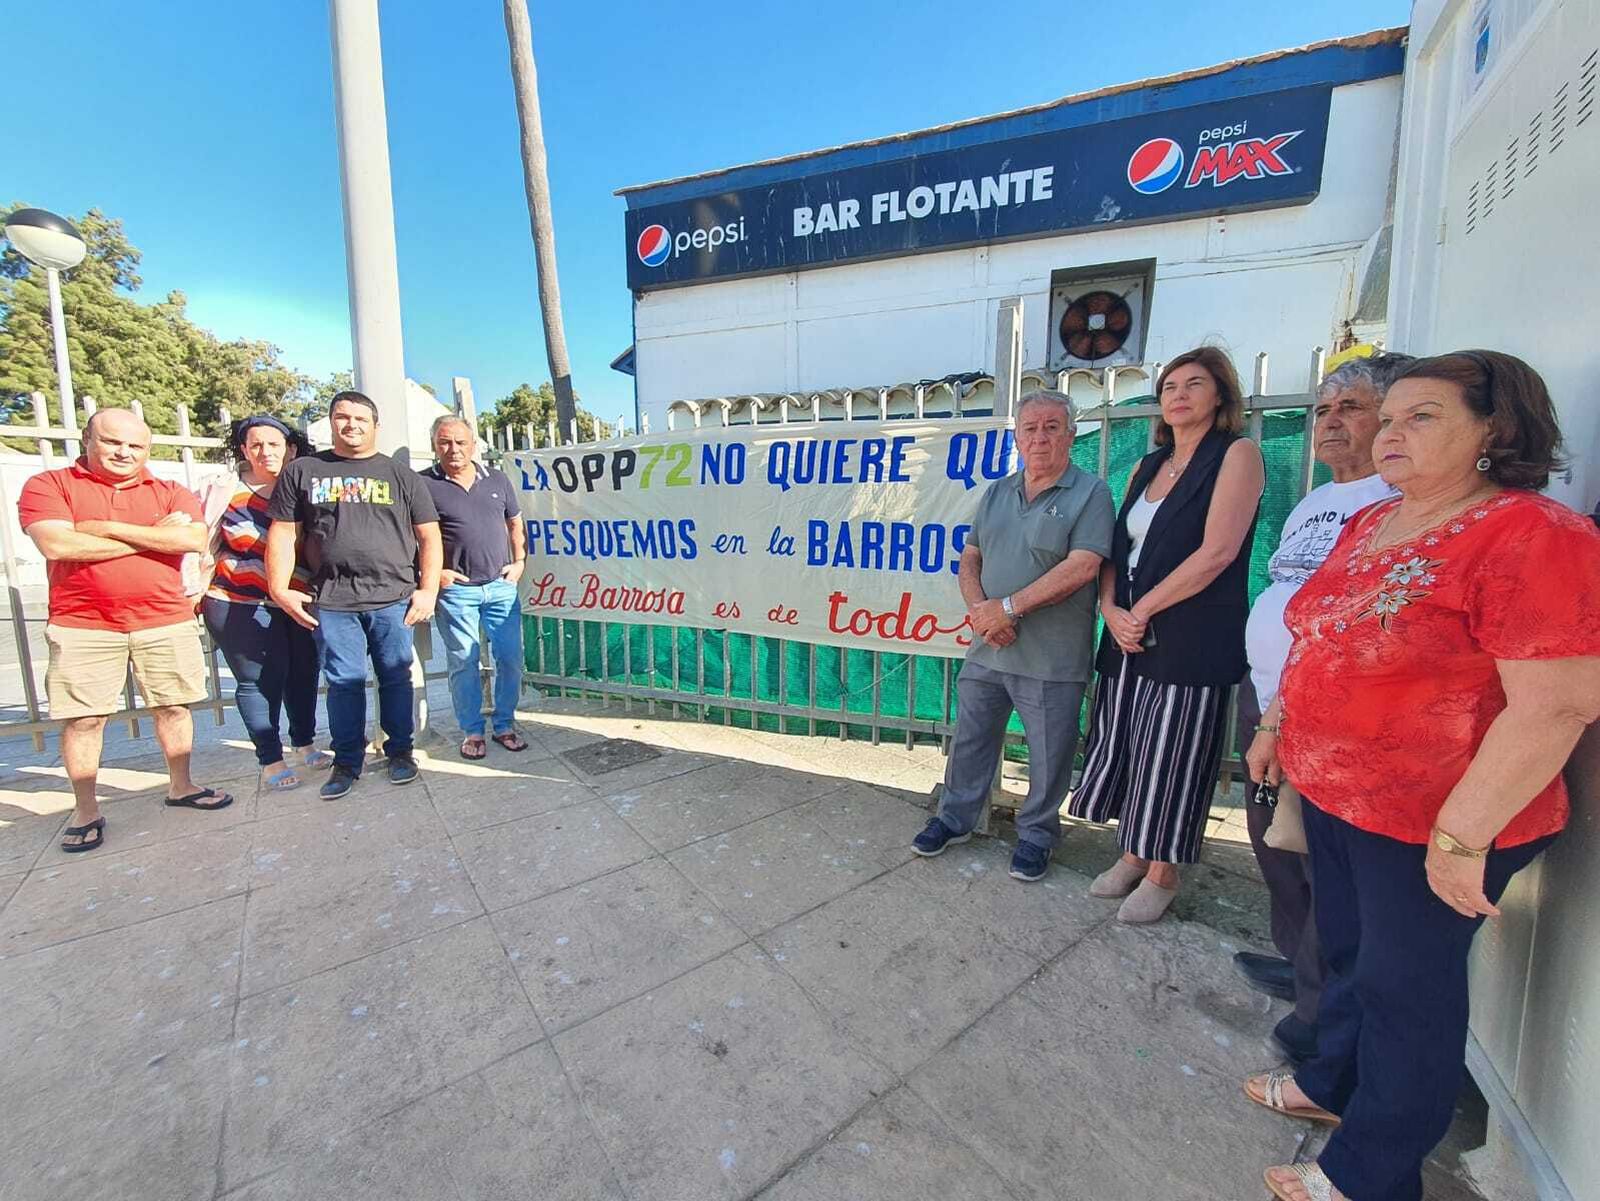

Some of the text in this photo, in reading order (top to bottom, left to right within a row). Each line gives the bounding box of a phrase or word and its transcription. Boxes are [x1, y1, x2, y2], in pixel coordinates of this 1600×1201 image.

[1199, 119, 1247, 144] pepsi
[1184, 129, 1305, 188] MAX
[793, 166, 1054, 237] BAR FLOTANTE
[675, 216, 744, 258] pepsi
[700, 443, 746, 485] NO
[767, 436, 916, 493] QUIERE
[946, 428, 1024, 491] QU
[311, 477, 394, 505] MARVEL
[526, 518, 698, 562] PESQUEMOS
[711, 533, 748, 555] en
[765, 525, 796, 556] la
[528, 572, 975, 646] La Barrosa es de todos
